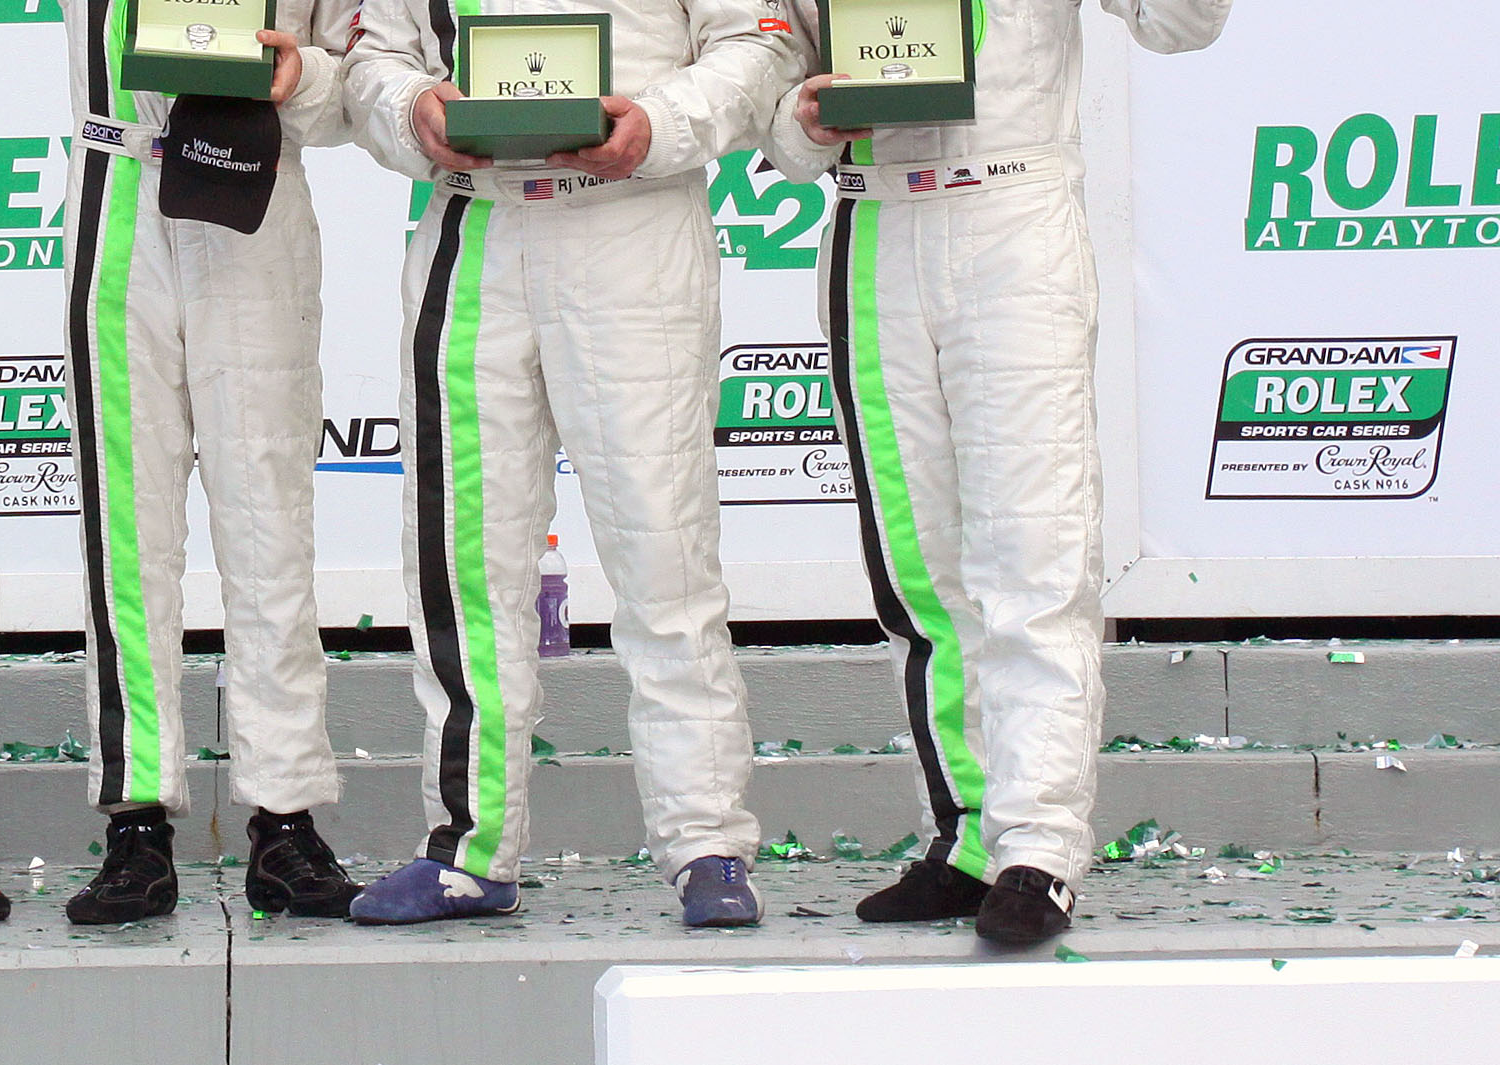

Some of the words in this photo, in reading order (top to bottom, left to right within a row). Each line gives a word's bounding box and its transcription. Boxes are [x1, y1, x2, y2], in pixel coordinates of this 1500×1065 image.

[858, 43, 937, 60] ROLEX
[192, 138, 233, 160] Wheel
[181, 145, 261, 173] Enhancement
[986, 161, 1027, 177] Marks
[1254, 220, 1317, 248] AT
[1254, 375, 1413, 414] ROLEX
[728, 430, 795, 443] SPORTS
[799, 430, 834, 441] CAR
[1240, 425, 1308, 437] SPORTS
[1312, 425, 1347, 437] CAR
[1351, 424, 1410, 436] SERIES
[1292, 463, 1308, 471] BY
[1315, 444, 1367, 475] Crown
[1352, 445, 1426, 477] Royal
[780, 468, 795, 476] BY
[1334, 479, 1371, 490] CASK
[3, 496, 38, 507] CASK
